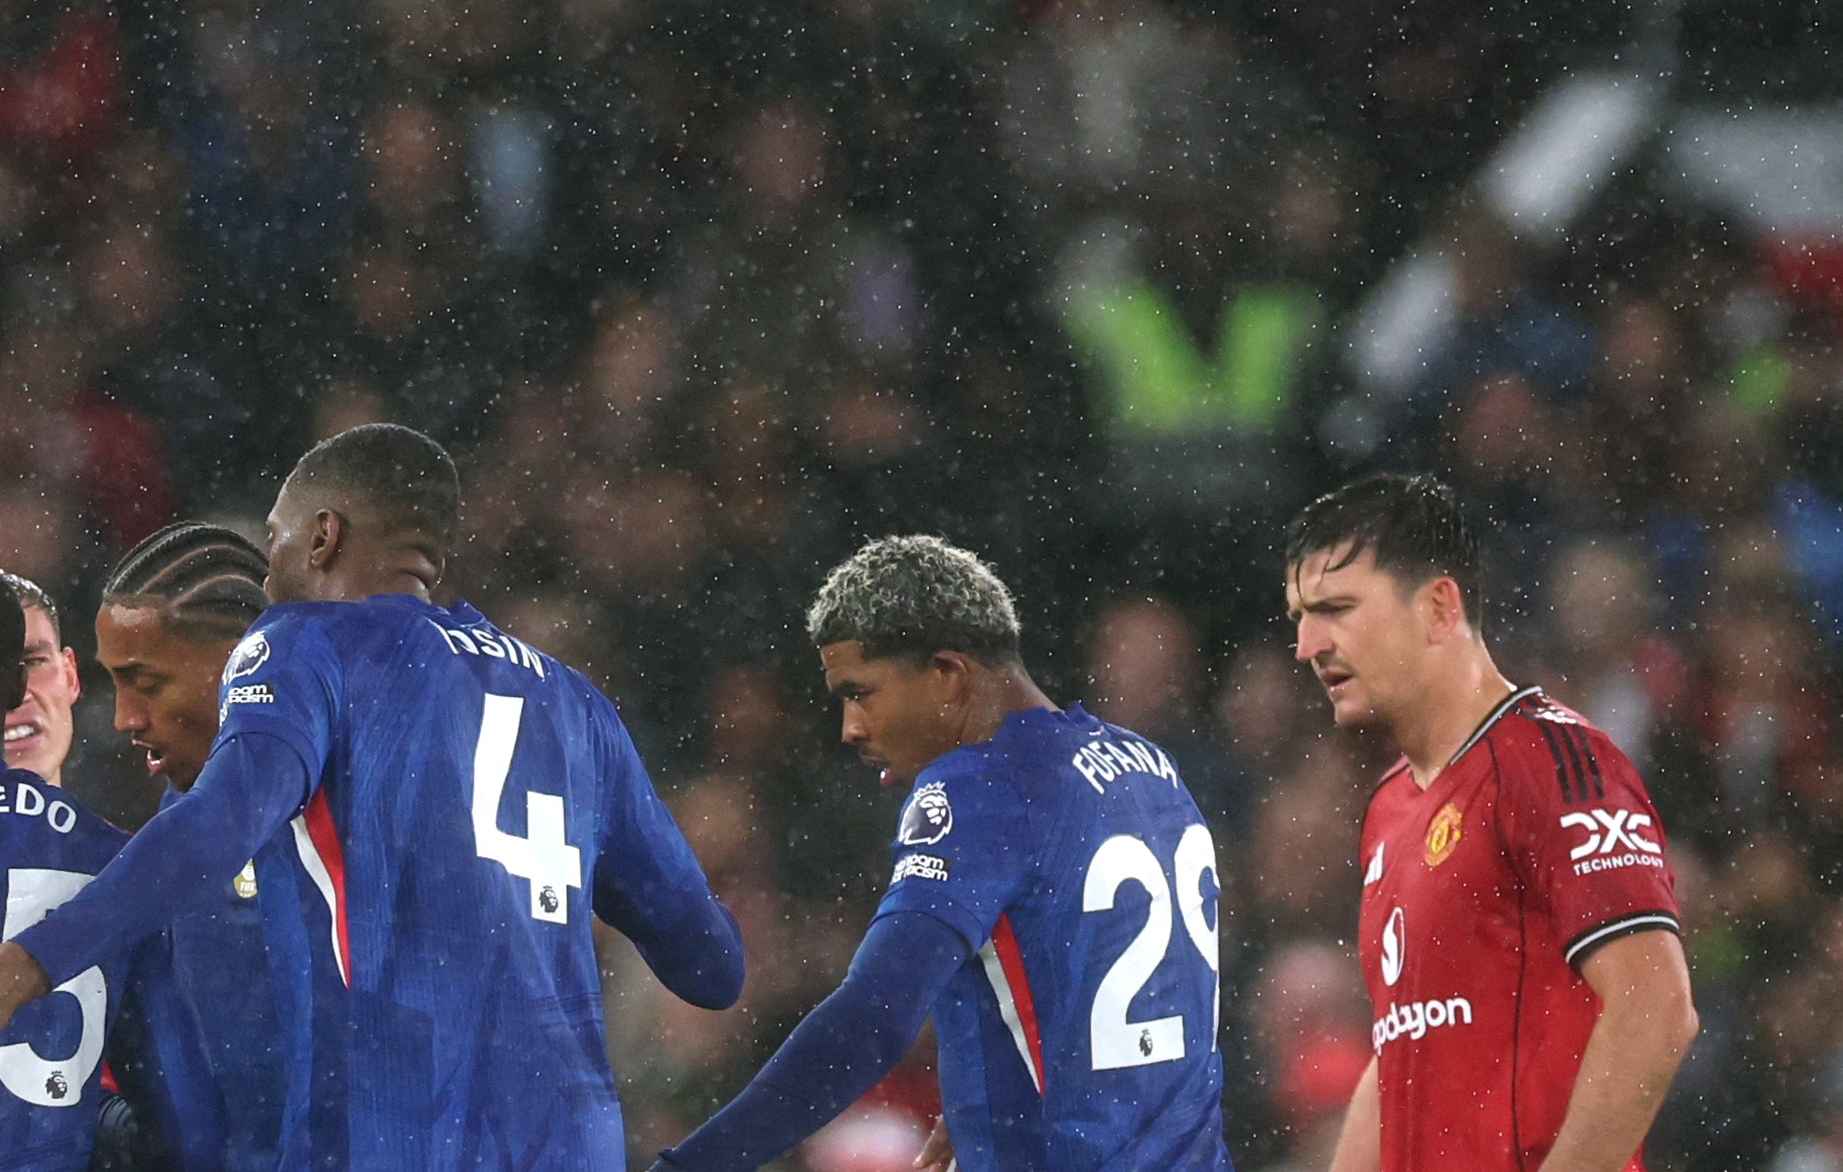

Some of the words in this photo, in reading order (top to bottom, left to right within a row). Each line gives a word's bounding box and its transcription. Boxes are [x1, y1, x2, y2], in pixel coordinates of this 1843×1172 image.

[472, 693, 582, 924] 4
[1072, 740, 1178, 795] FOFANA
[1560, 808, 1662, 862] DXC
[1082, 823, 1222, 1072] 29
